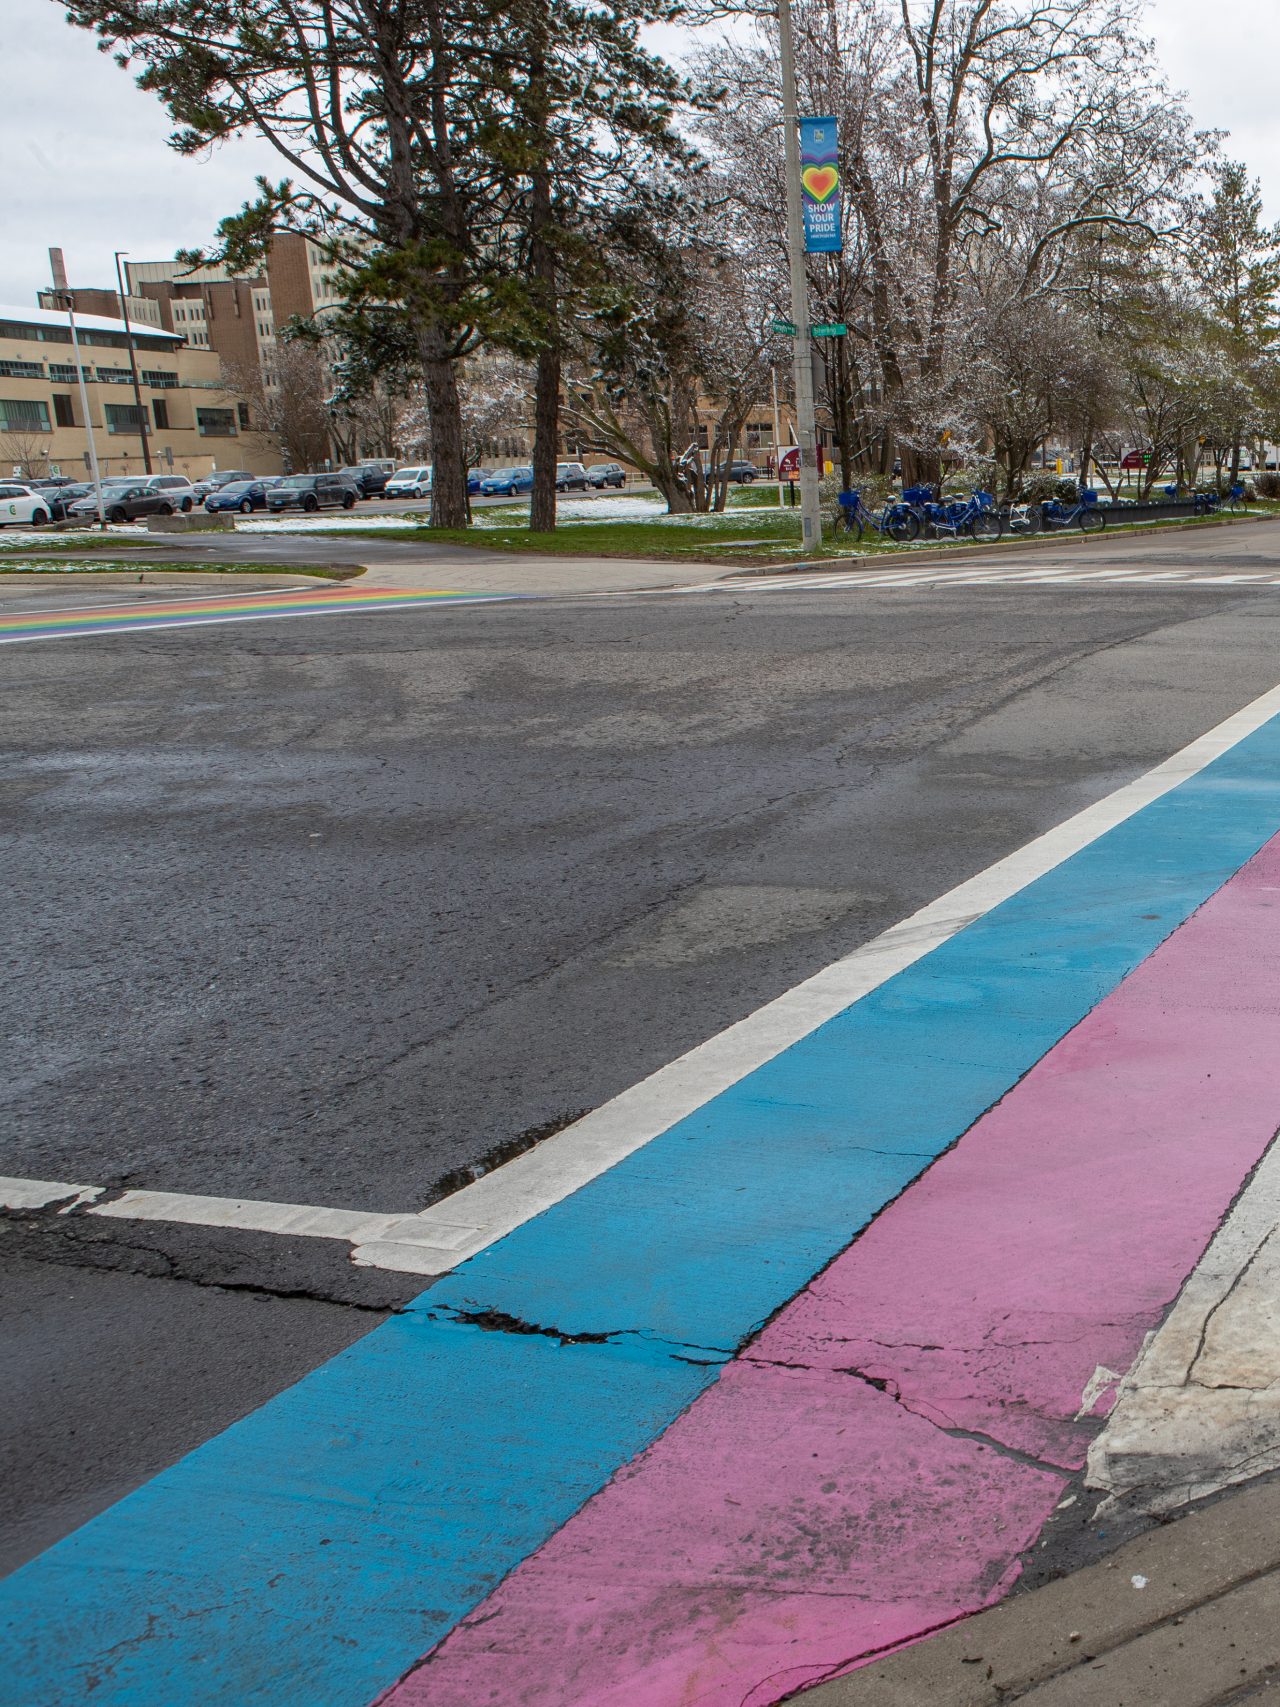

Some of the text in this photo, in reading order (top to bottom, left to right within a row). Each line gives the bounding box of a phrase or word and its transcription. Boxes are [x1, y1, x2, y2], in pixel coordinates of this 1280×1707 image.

[808, 203, 836, 213] SHOW
[809, 213, 834, 223] YOUR
[809, 222, 836, 233] PRIDE
